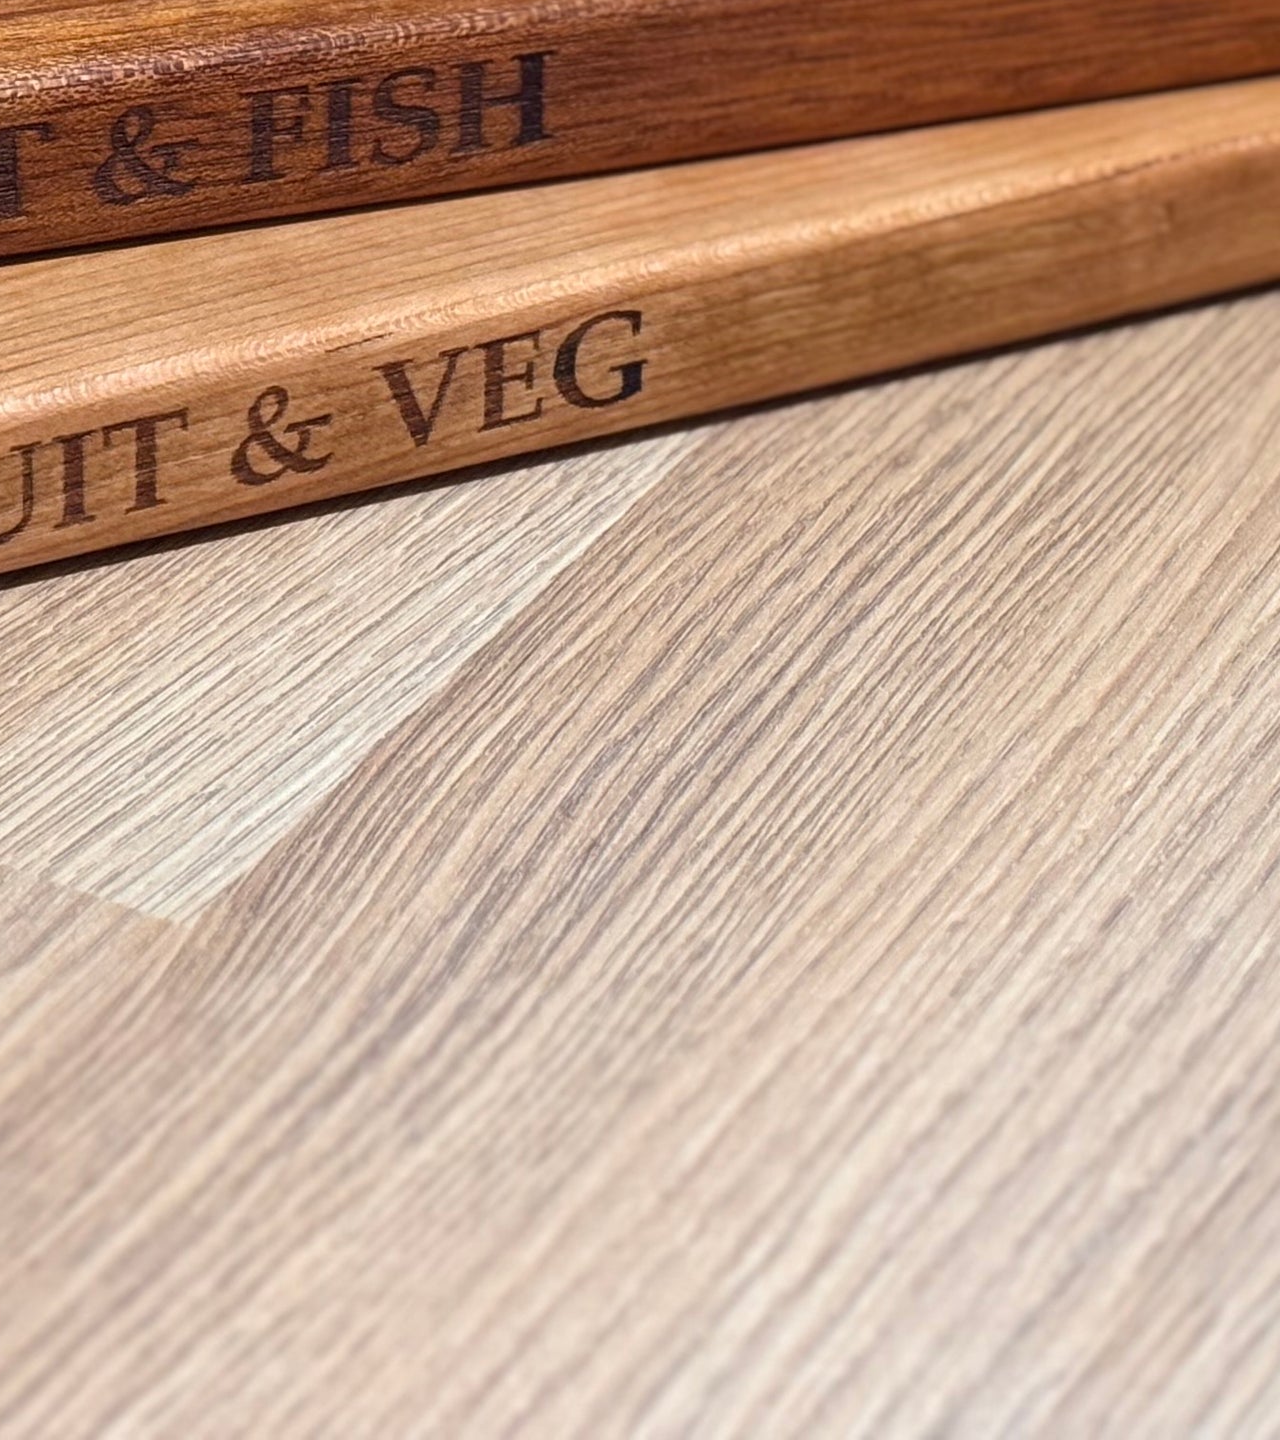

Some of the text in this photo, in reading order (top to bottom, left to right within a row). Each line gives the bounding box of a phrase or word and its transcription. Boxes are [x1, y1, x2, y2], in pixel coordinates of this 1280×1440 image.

[89, 103, 200, 207] &
[242, 49, 557, 185] FISH
[229, 385, 333, 487] &
[372, 309, 649, 448] VEG
